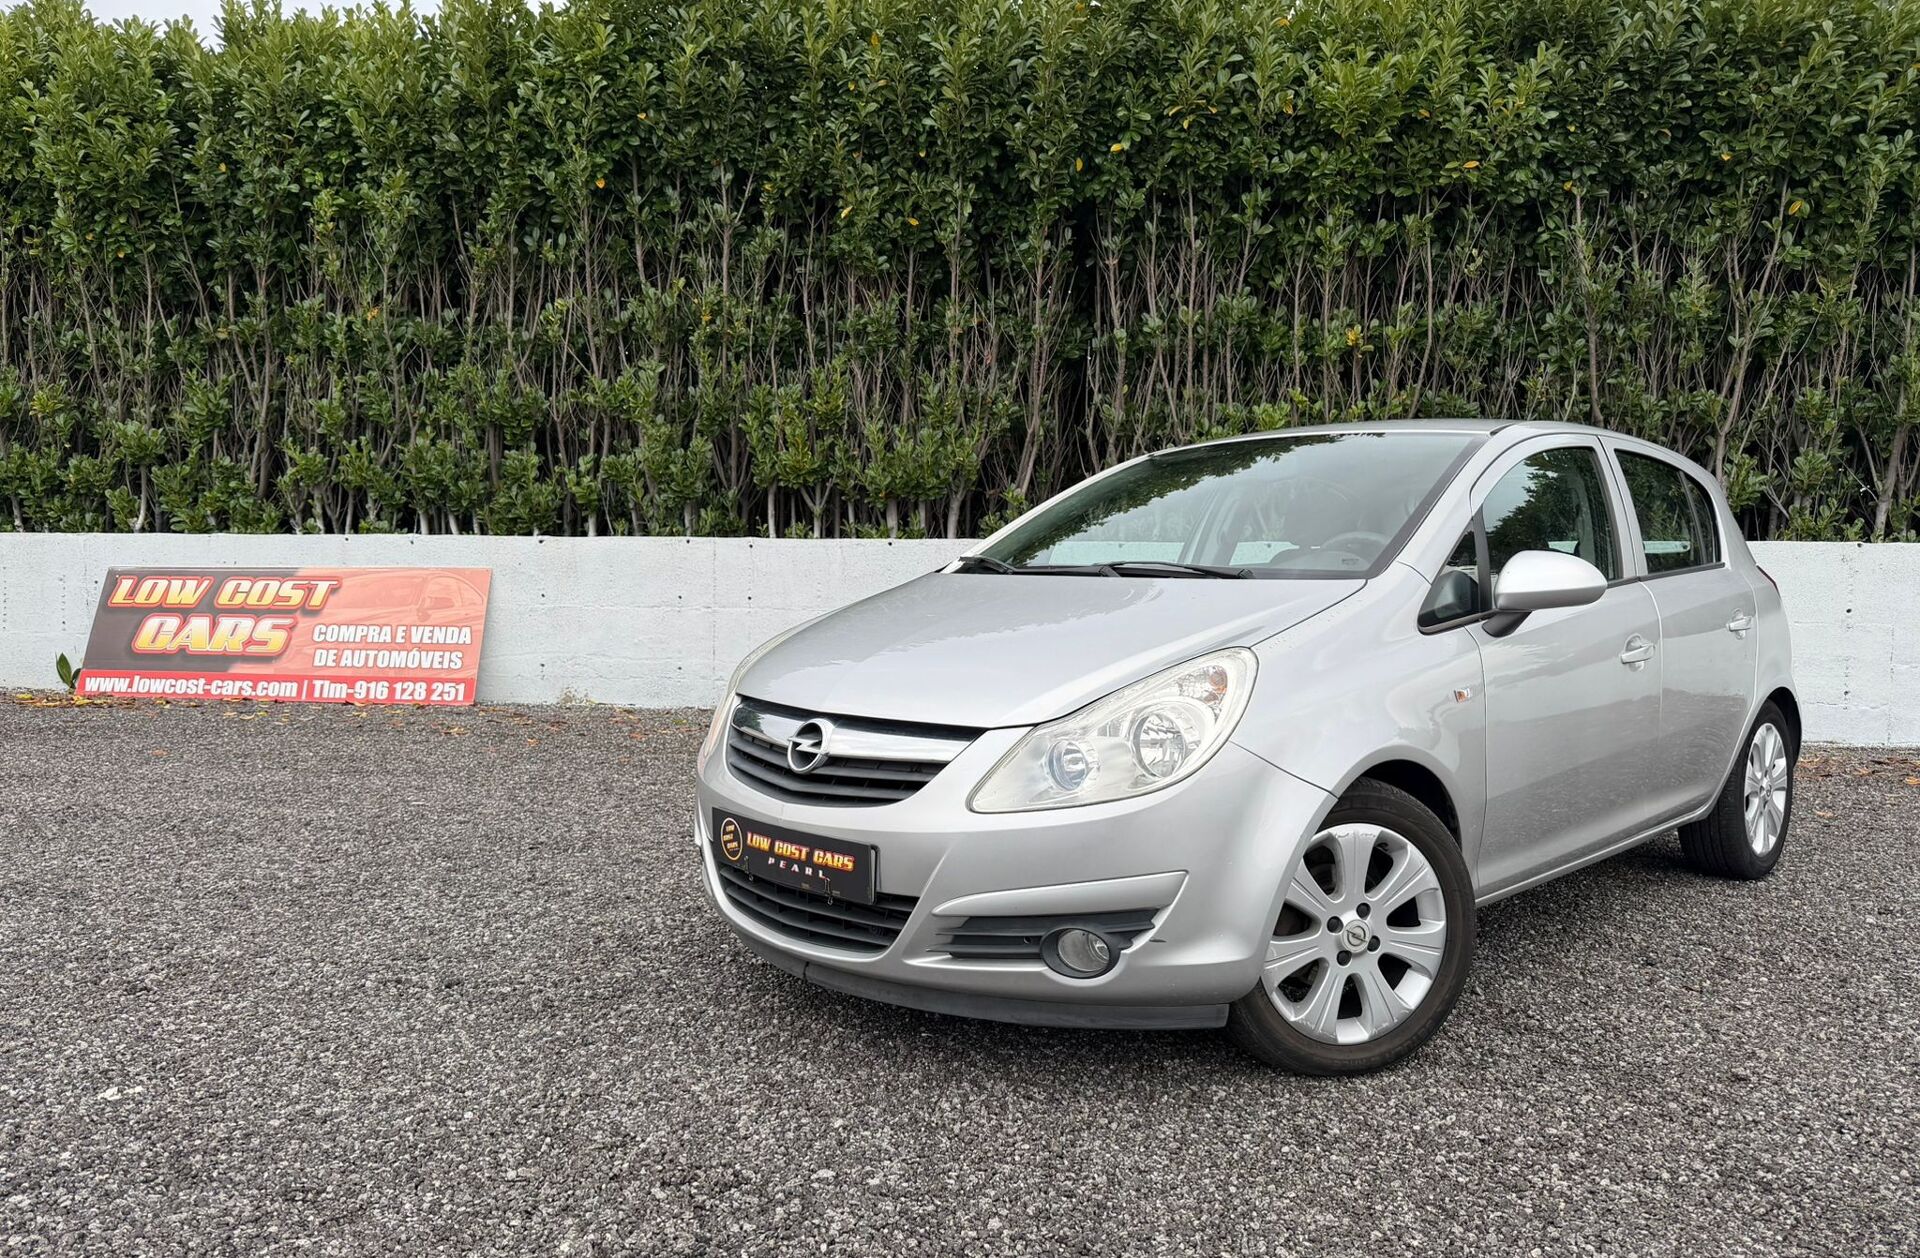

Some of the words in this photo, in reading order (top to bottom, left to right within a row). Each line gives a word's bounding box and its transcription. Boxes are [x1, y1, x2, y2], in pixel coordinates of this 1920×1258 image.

[109, 576, 213, 607] LOW
[215, 577, 341, 611] COST
[132, 613, 297, 656] CARS
[313, 624, 392, 643] COMPRA
[395, 625, 407, 643] E
[410, 625, 472, 645] VENDA
[313, 648, 338, 667] DE
[339, 647, 463, 669] AUTOMÓVEIS
[84, 675, 298, 697] www.lowcost-cars.com
[393, 681, 427, 700] 128
[430, 682, 466, 701] 251
[747, 832, 772, 853] LOW
[774, 840, 810, 862] COST
[812, 848, 855, 872] CARS
[768, 857, 826, 879] PEARL
